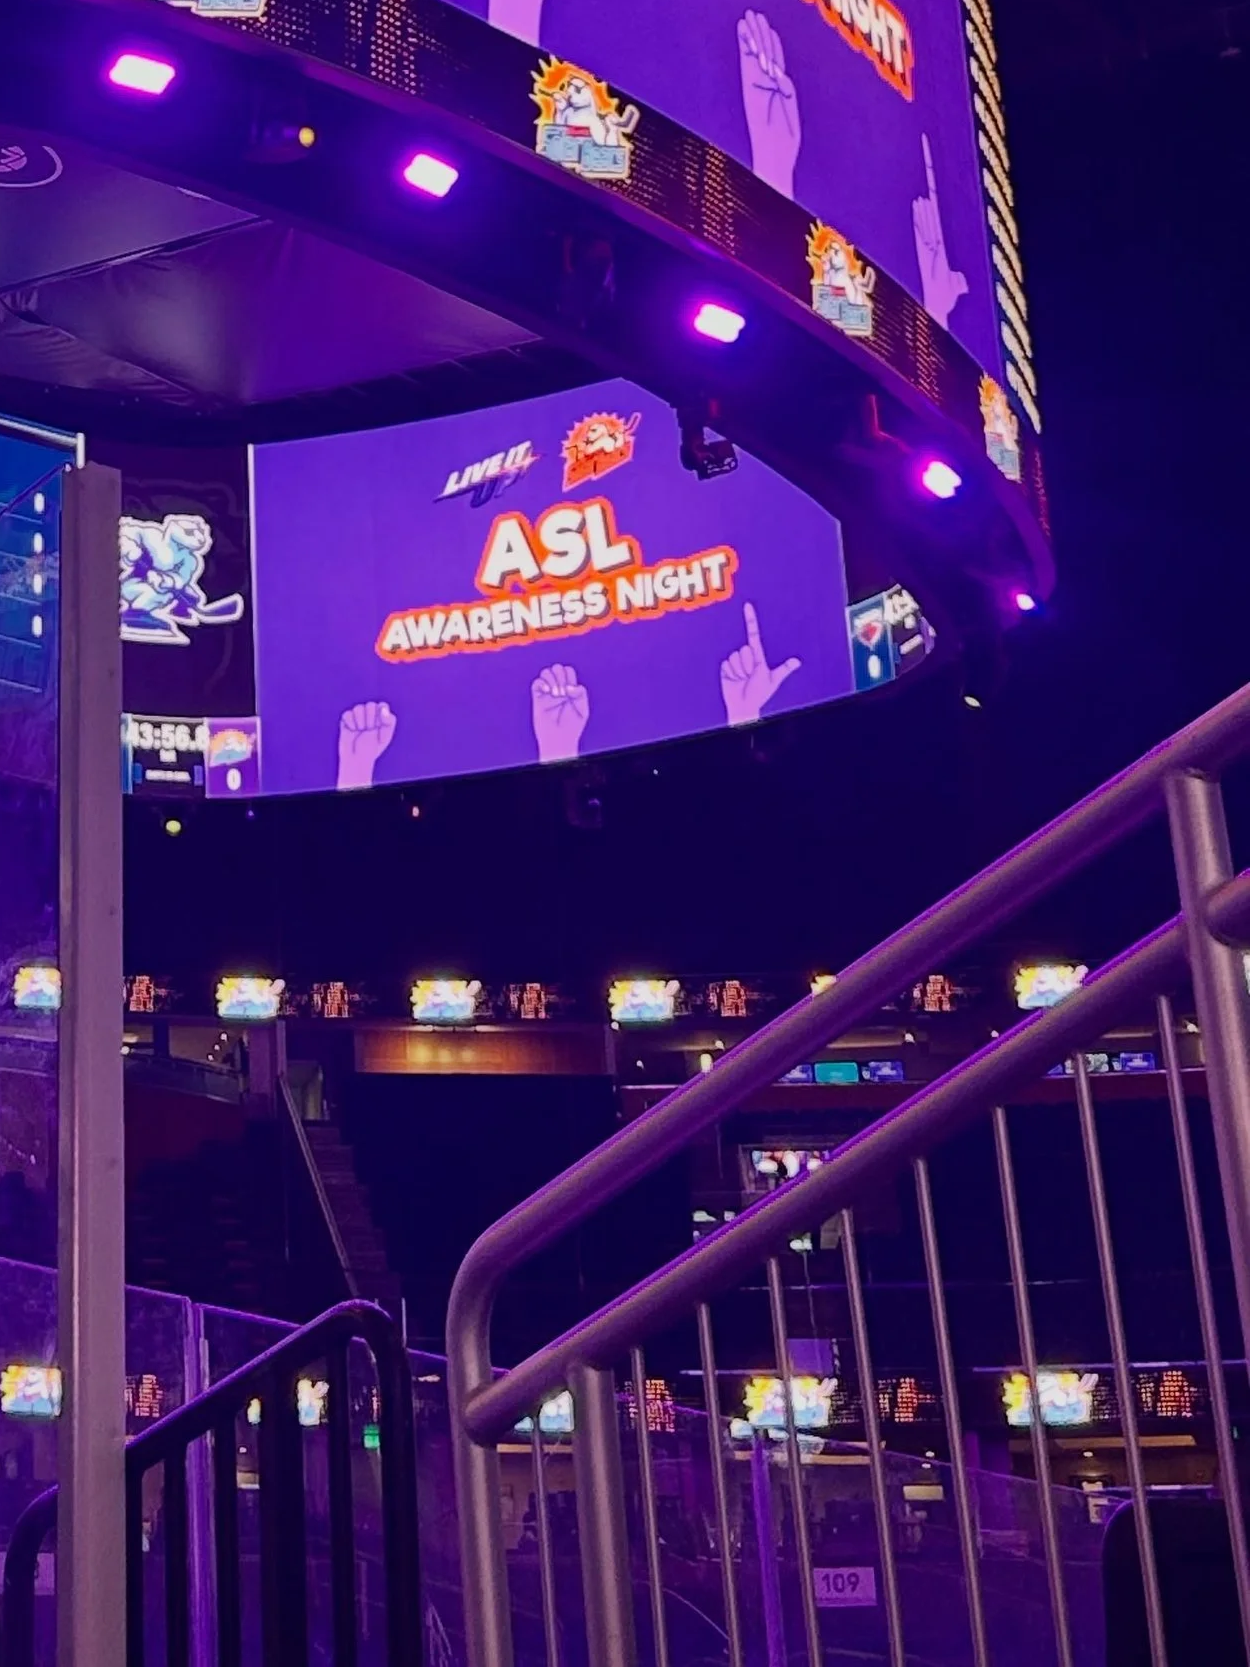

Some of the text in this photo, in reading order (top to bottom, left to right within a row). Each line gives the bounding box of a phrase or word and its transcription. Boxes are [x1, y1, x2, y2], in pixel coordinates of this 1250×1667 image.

[443, 440, 531, 496] LIVE IT
[482, 504, 631, 588] ASL
[383, 555, 728, 654] AWARENESS NIGHT
[822, 1573, 859, 1593] 109
